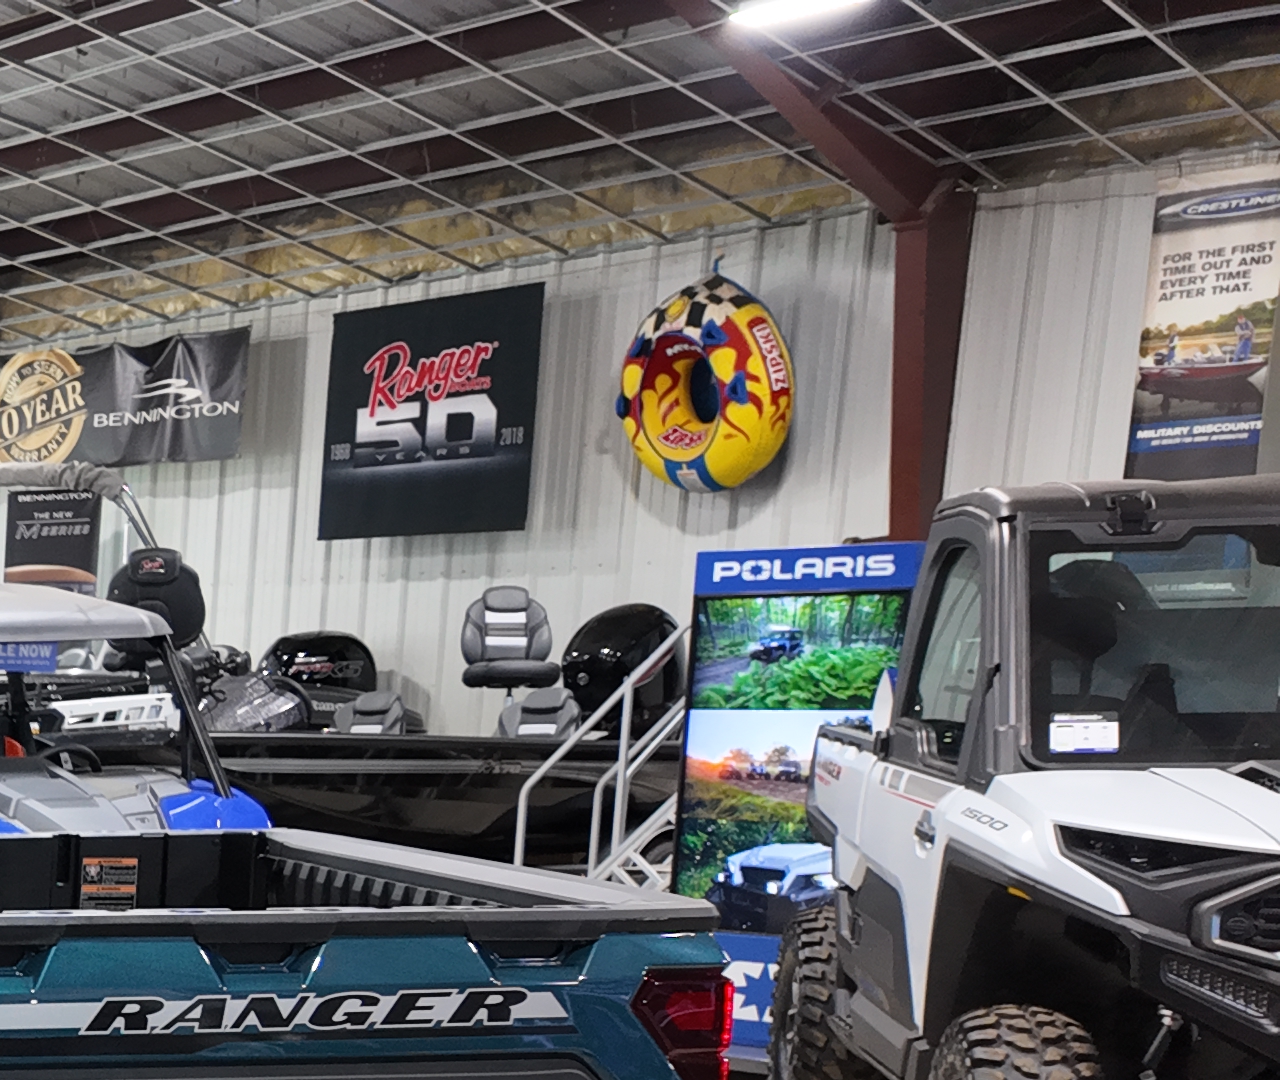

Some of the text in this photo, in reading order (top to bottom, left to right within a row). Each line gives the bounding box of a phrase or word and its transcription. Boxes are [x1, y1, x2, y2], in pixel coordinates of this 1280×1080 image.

[1186, 193, 1280, 214] CRESTLINE
[1162, 240, 1276, 264] FOR THE FIRST
[1161, 254, 1272, 277] TIME OUT AND
[1159, 269, 1251, 290] EVERY TIME
[1158, 282, 1252, 302] AFTER THAT.
[363, 340, 493, 418] Ranger
[21, 381, 85, 429] YEAR
[92, 400, 240, 428] BENNINGTON
[499, 426, 524, 445] 2018
[1136, 420, 1263, 439] MILITARY DISCOUNTS
[375, 446, 471, 461] YEARS
[17, 492, 92, 502] BENNINGTON
[33, 510, 74, 520] THE NEW
[713, 554, 896, 582] POLARIS
[19, 644, 53, 658] NOW
[961, 807, 1008, 831] 1500
[78, 987, 530, 1035] RANGER
